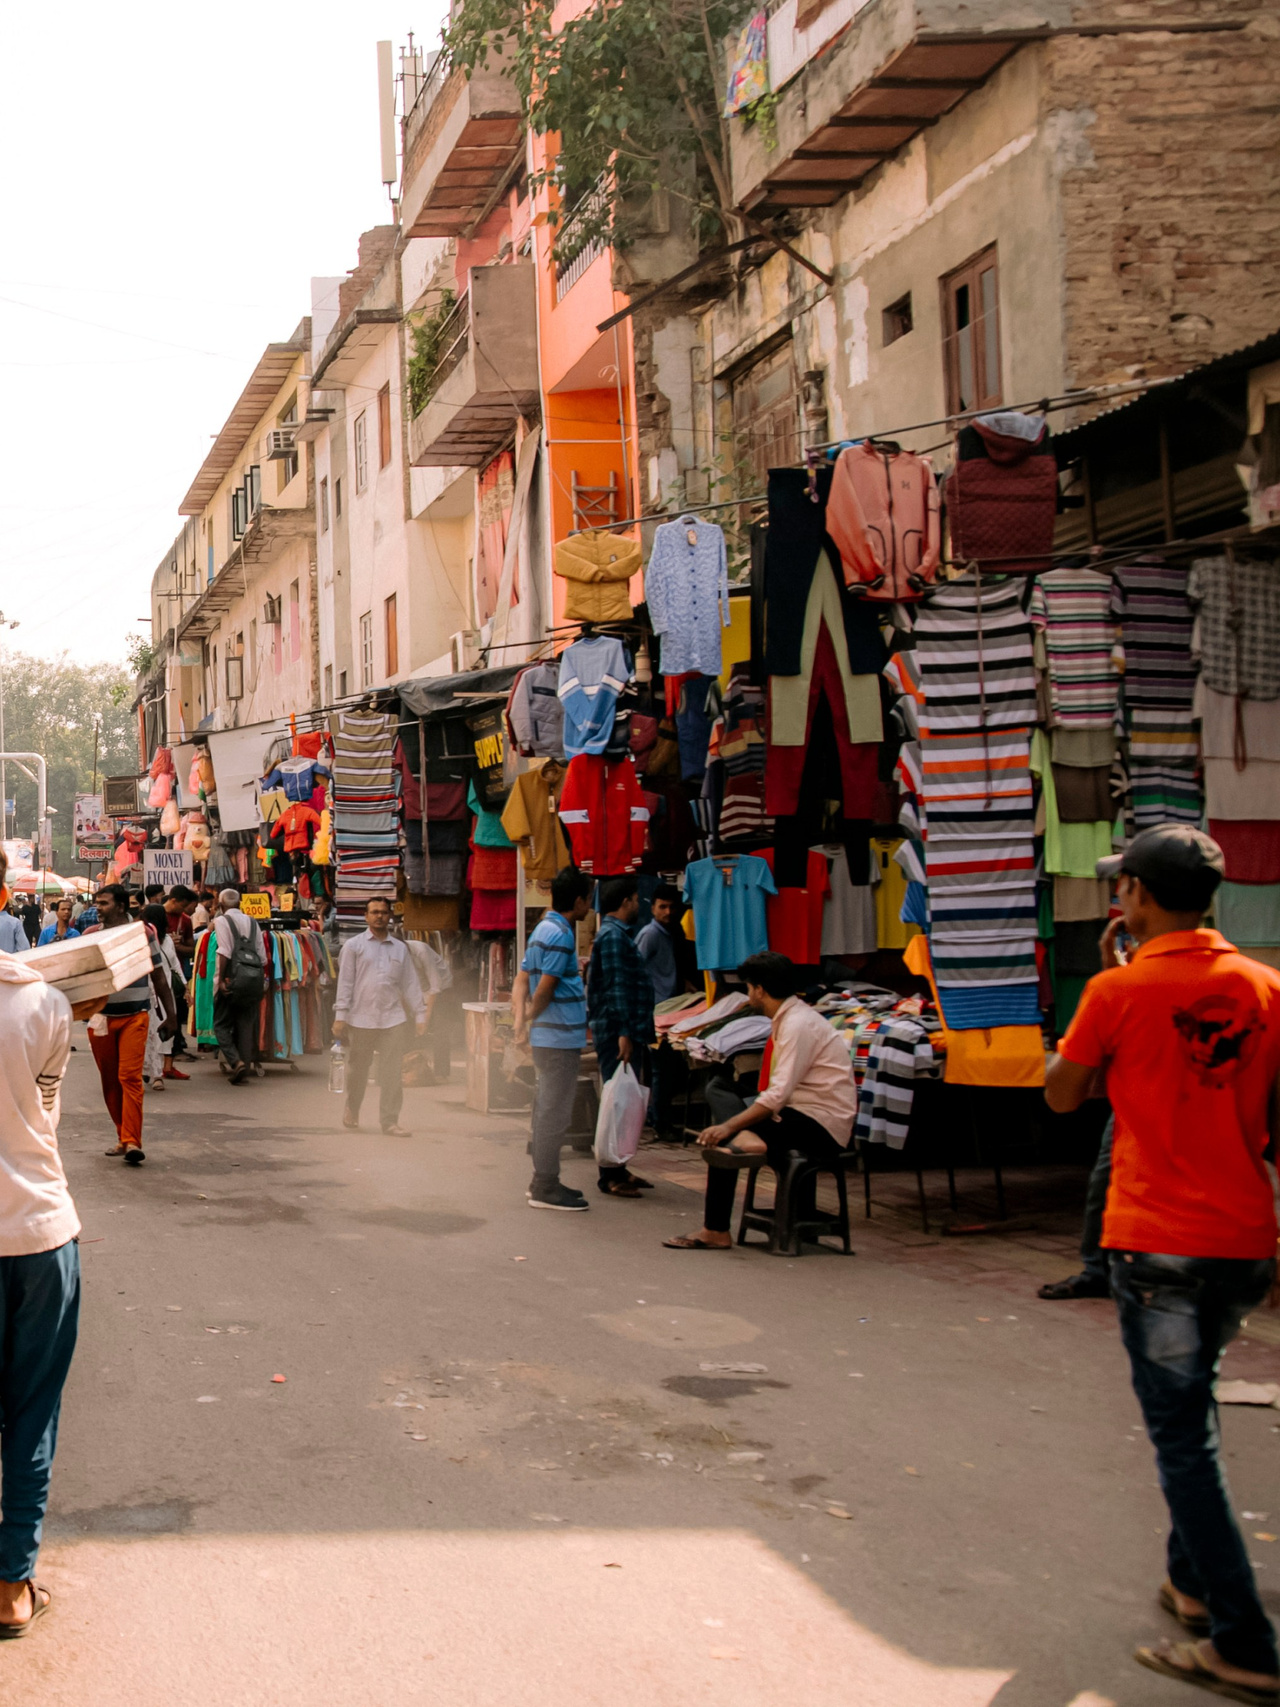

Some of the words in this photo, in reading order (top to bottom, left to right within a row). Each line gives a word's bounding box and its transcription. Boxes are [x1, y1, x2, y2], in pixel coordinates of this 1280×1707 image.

[79, 846, 112, 859] दिलबाग
[154, 853, 185, 868] MONEY
[147, 870, 191, 886] EXCHANGE
